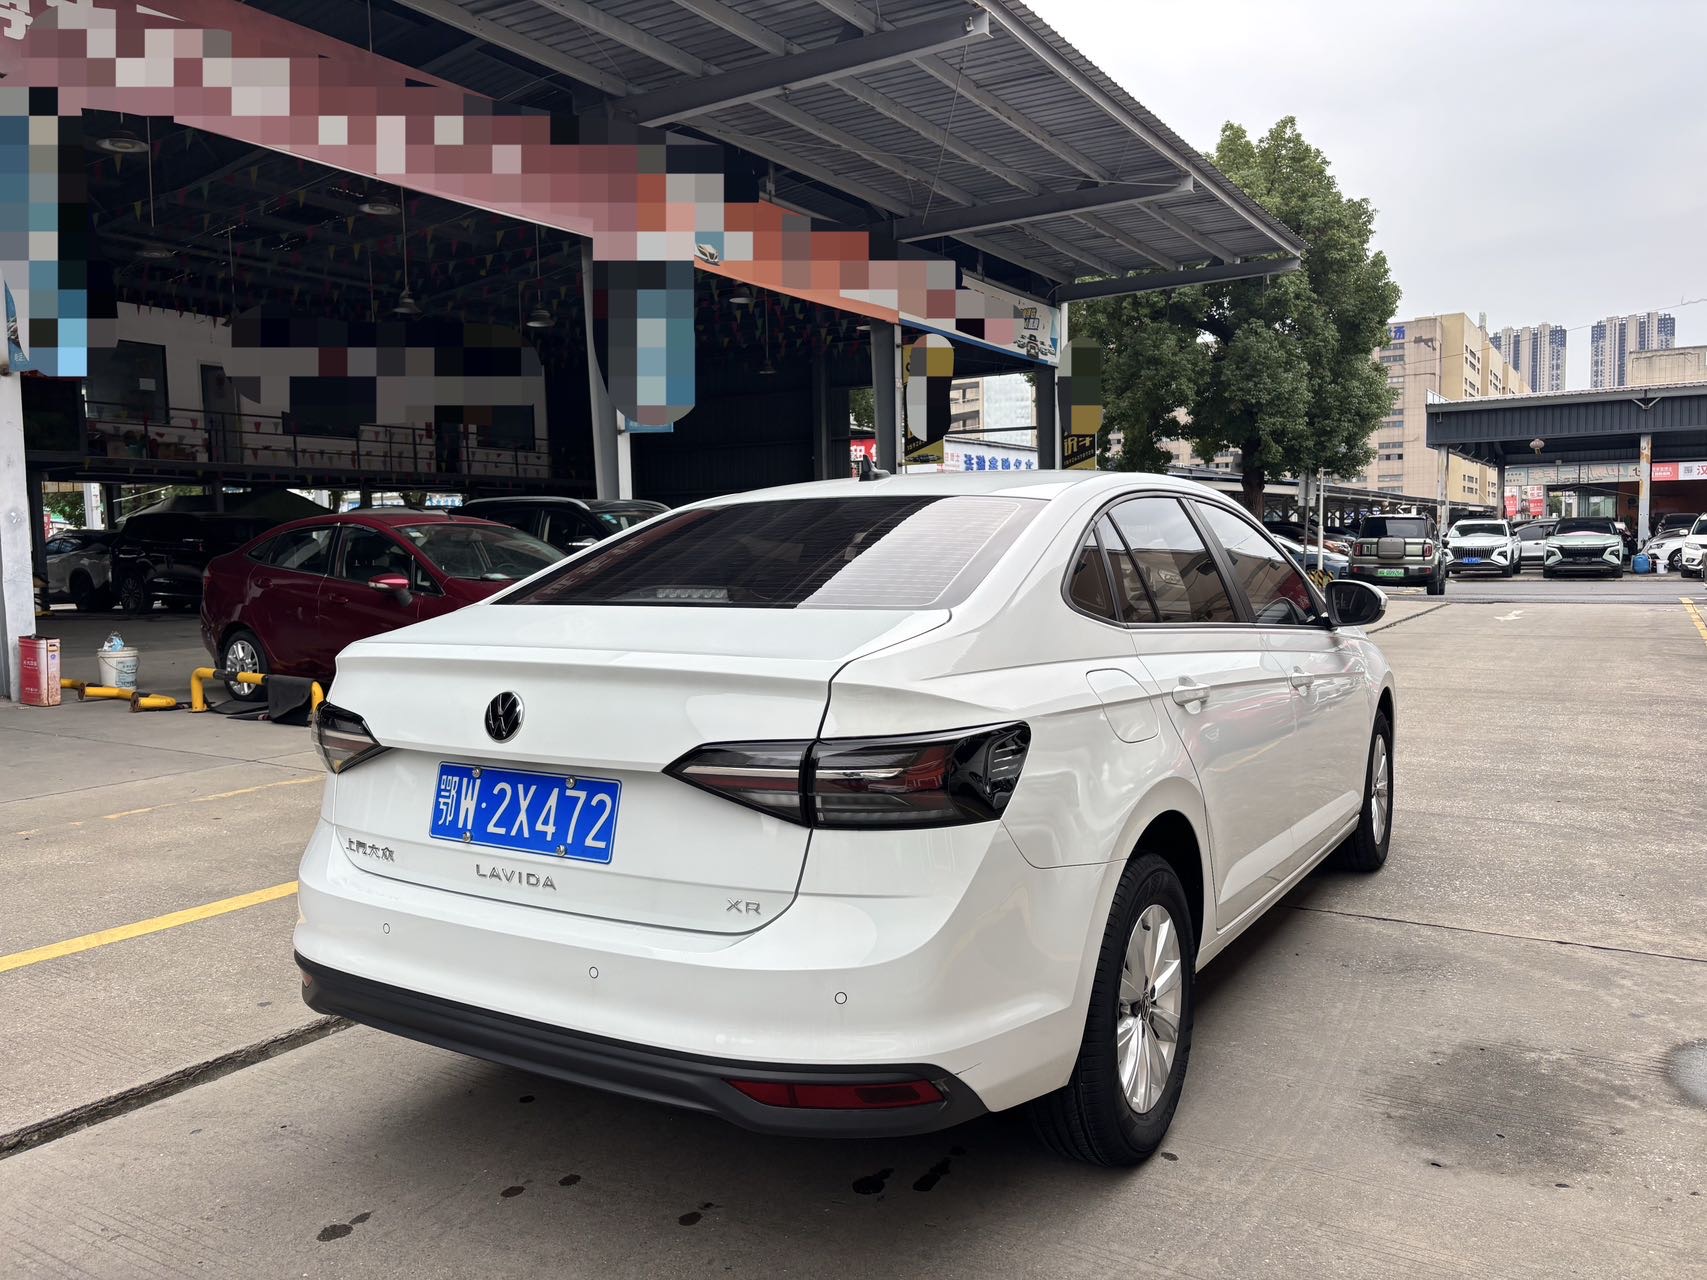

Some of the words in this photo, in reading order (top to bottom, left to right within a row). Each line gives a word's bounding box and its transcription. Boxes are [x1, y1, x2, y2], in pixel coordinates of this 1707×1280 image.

[345, 838, 395, 862] 上汽大众
[475, 863, 557, 891] LAVIDA
[726, 898, 761, 915] XR
